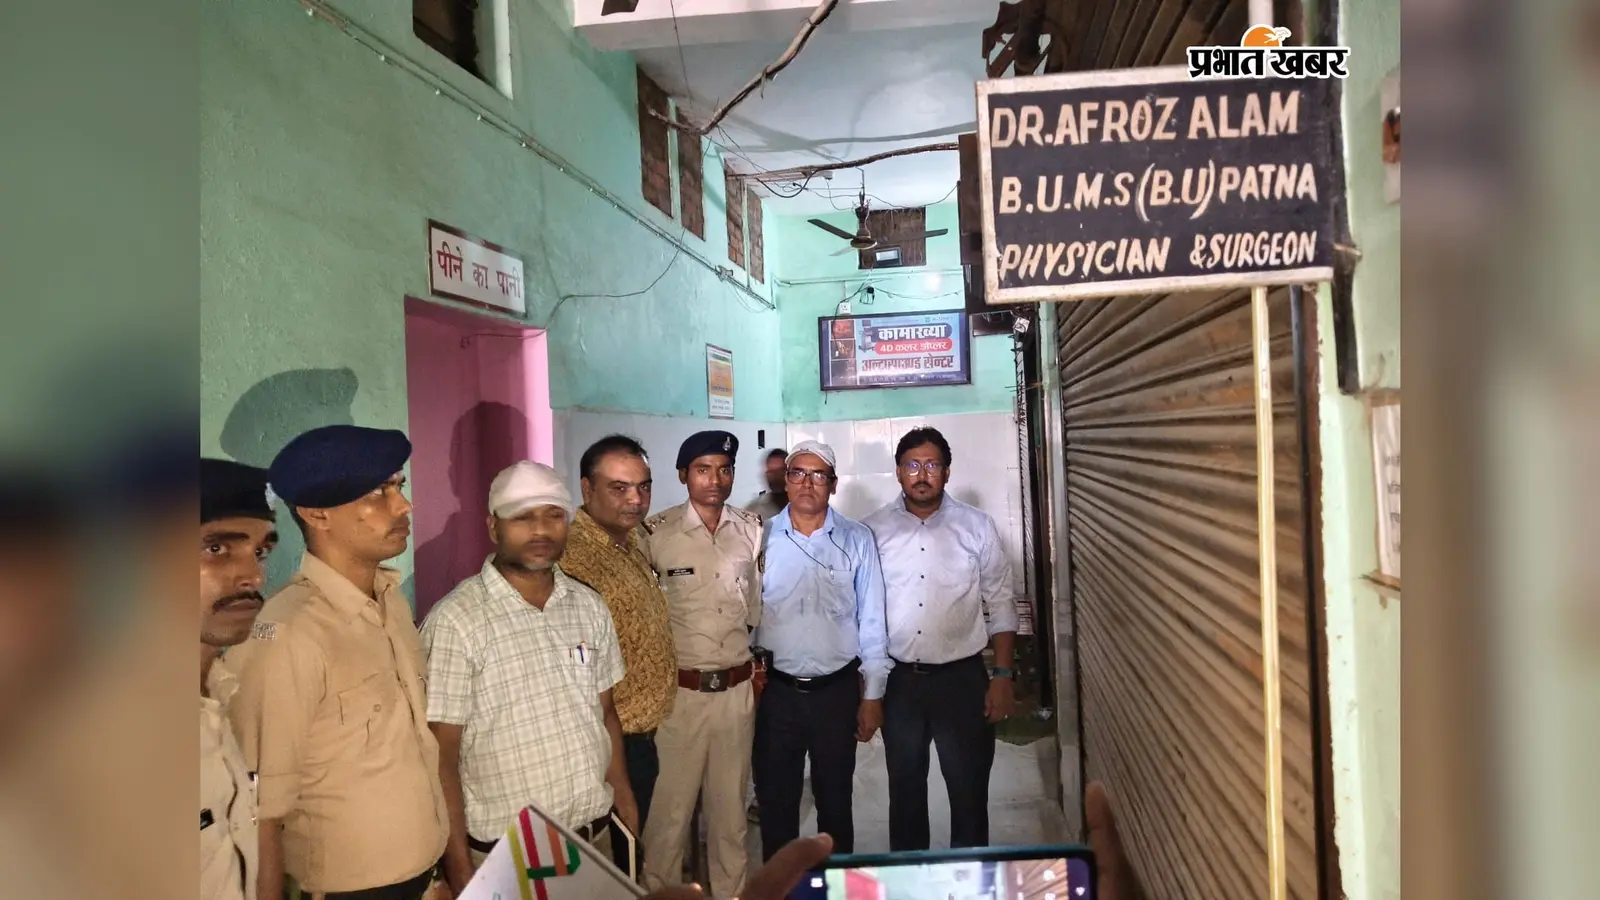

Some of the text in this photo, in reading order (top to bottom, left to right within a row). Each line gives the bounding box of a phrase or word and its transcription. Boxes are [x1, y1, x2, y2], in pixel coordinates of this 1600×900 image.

[1187, 90, 1301, 140] ALAM
[1219, 162, 1318, 204] PATNA
[436, 241, 521, 298] पीने का पानी
[999, 236, 1171, 281] PHYSICIAN
[878, 325, 947, 341] कामाख्या
[895, 343, 917, 352] कलर
